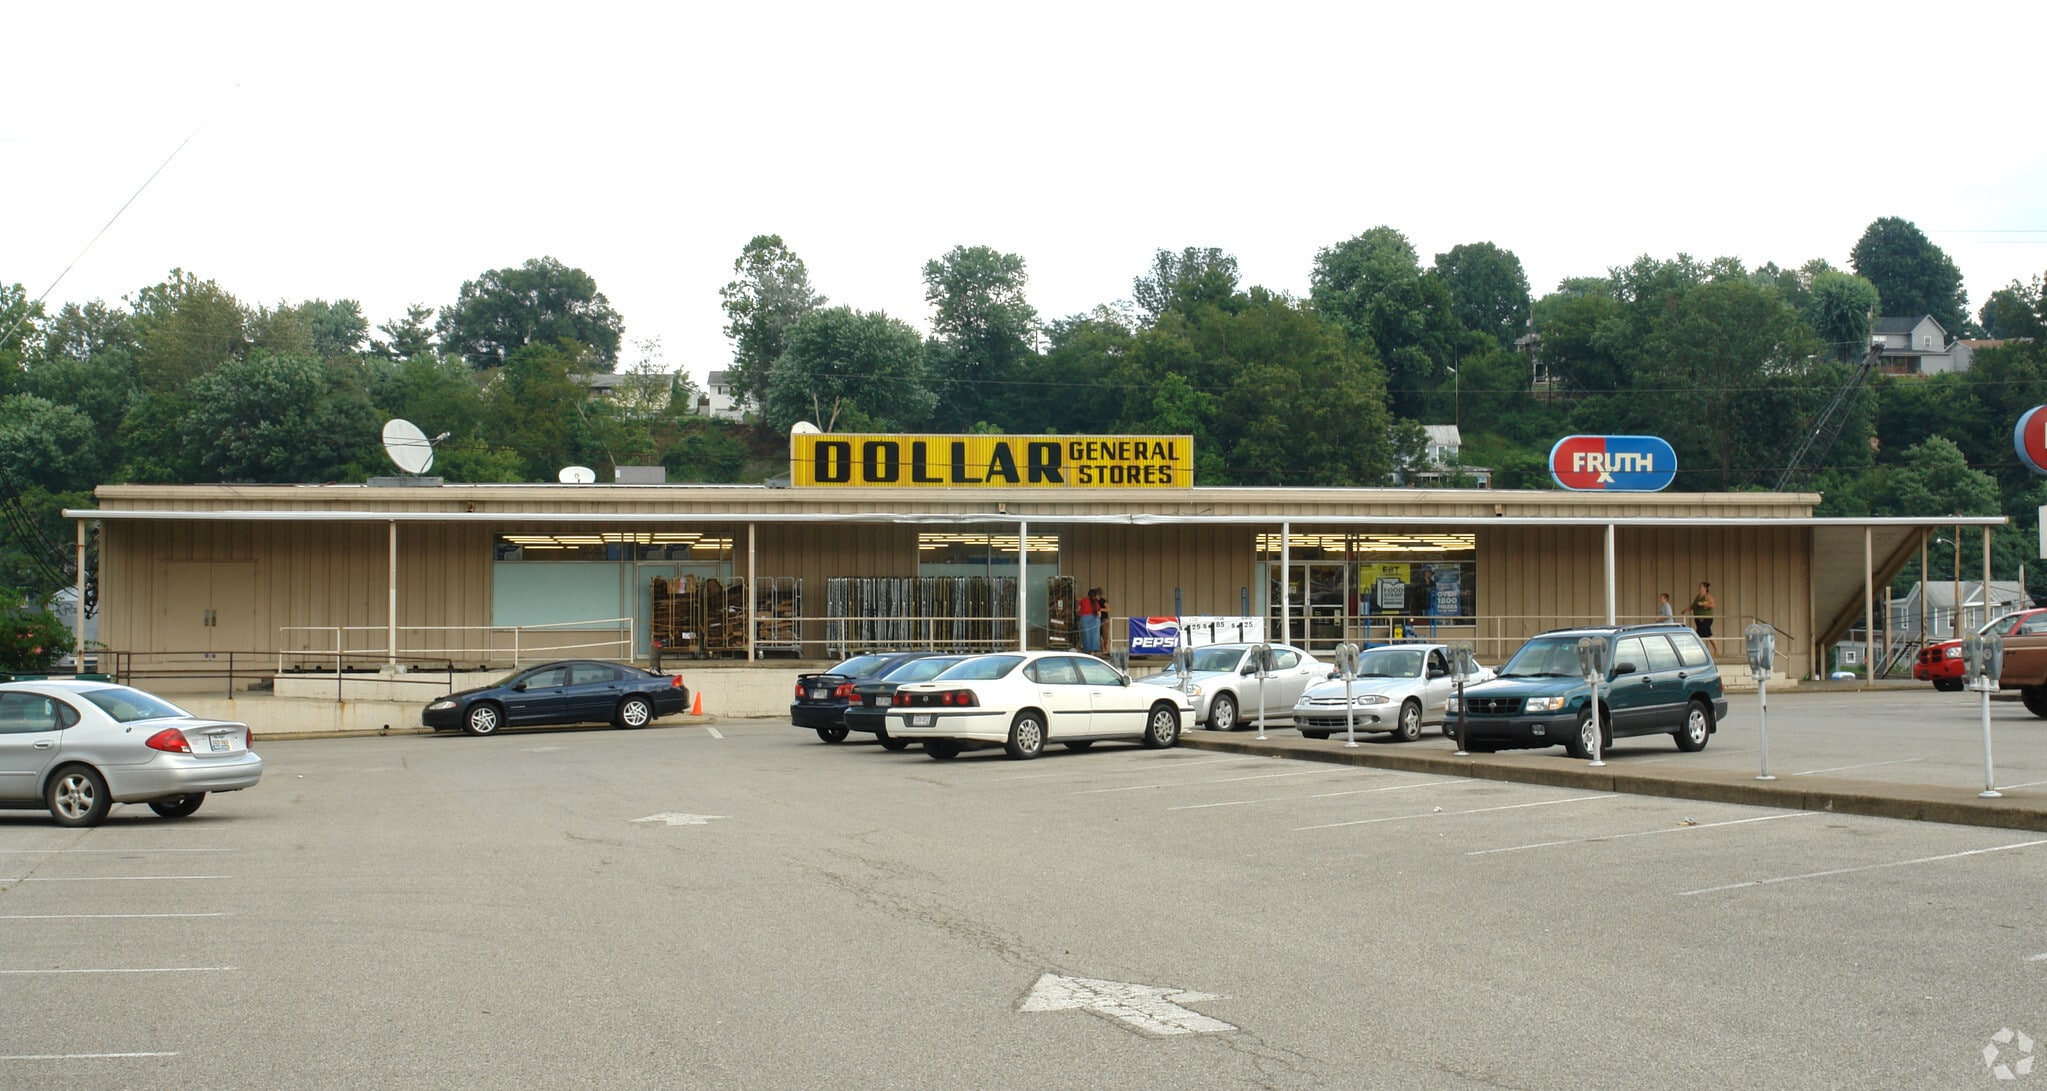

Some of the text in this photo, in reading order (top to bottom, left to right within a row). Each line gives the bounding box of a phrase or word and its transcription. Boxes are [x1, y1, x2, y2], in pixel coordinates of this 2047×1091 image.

[1069, 441, 1180, 461] GENERAL
[814, 440, 1065, 483] DOLLAR
[1573, 452, 1653, 473] FRUTH
[1078, 464, 1173, 484] STORES
[1132, 637, 1179, 648] PEPSI
